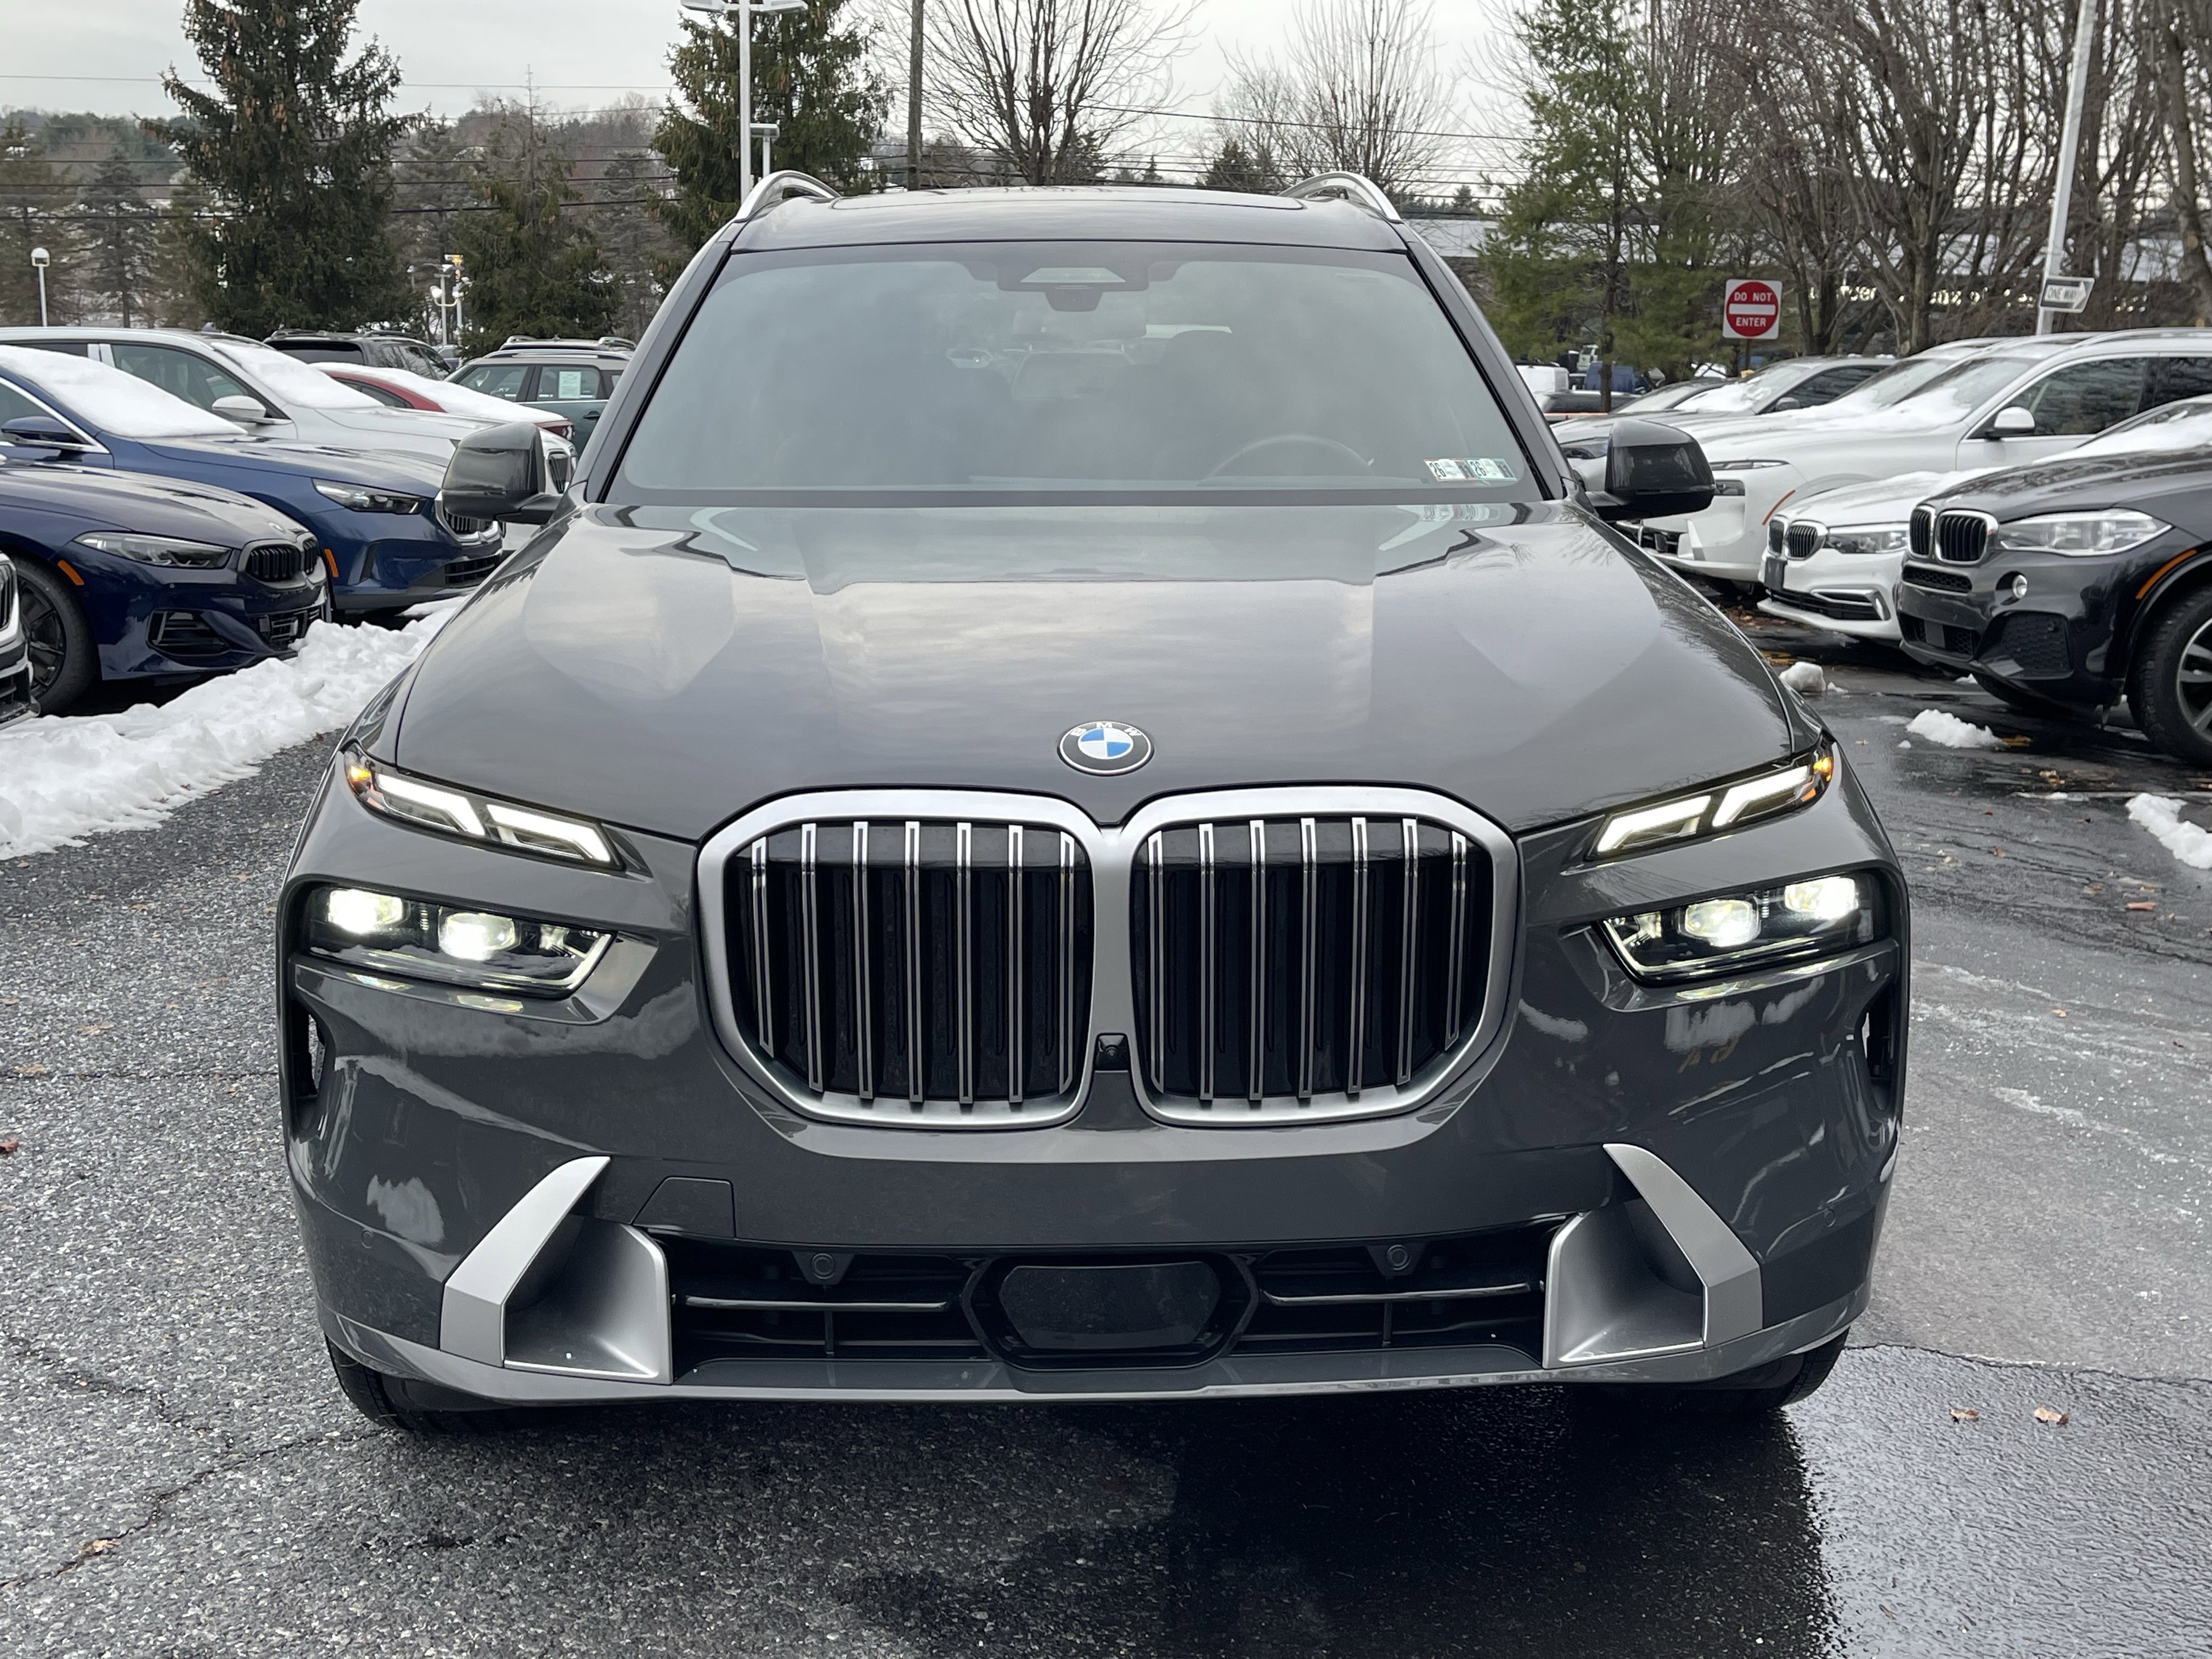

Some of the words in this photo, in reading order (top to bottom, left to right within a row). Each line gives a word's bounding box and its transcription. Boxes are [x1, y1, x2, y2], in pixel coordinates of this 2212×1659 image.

[1734, 292, 1747, 301] DO
[1753, 292, 1772, 302] NOT
[1736, 317, 1767, 327] ENTER
[1470, 461, 1487, 476] 26
[1070, 722, 1142, 737] BMW
